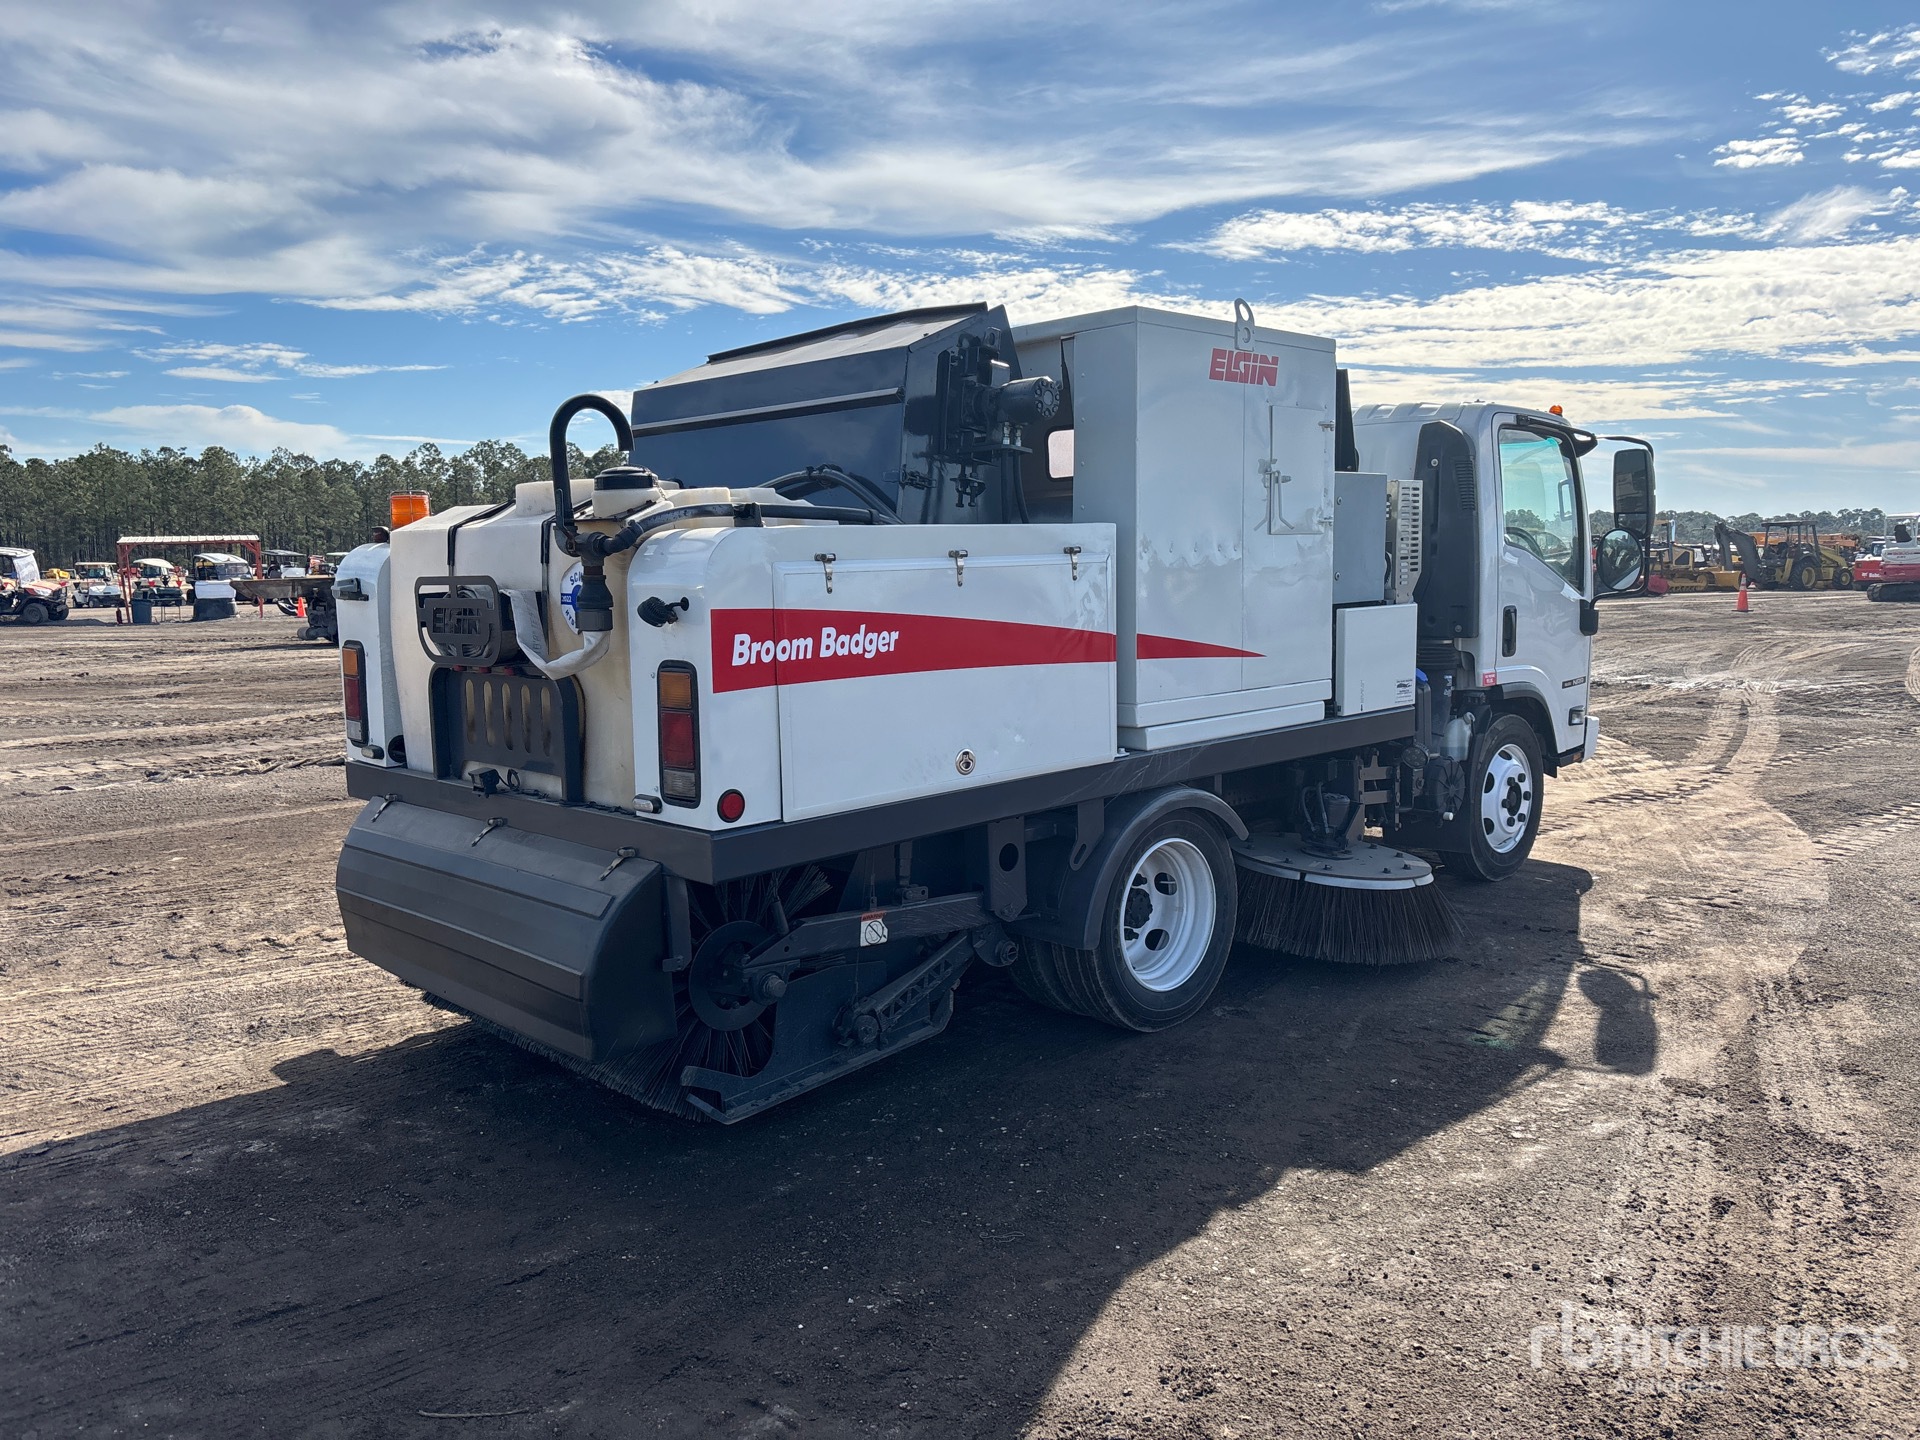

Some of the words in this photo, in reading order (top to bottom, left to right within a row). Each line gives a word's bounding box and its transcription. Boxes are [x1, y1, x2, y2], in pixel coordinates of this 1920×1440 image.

[1209, 348, 1279, 387] ELGIN
[433, 607, 481, 635] ELGIN
[732, 633, 814, 666] Broom
[820, 624, 900, 659] Badger
